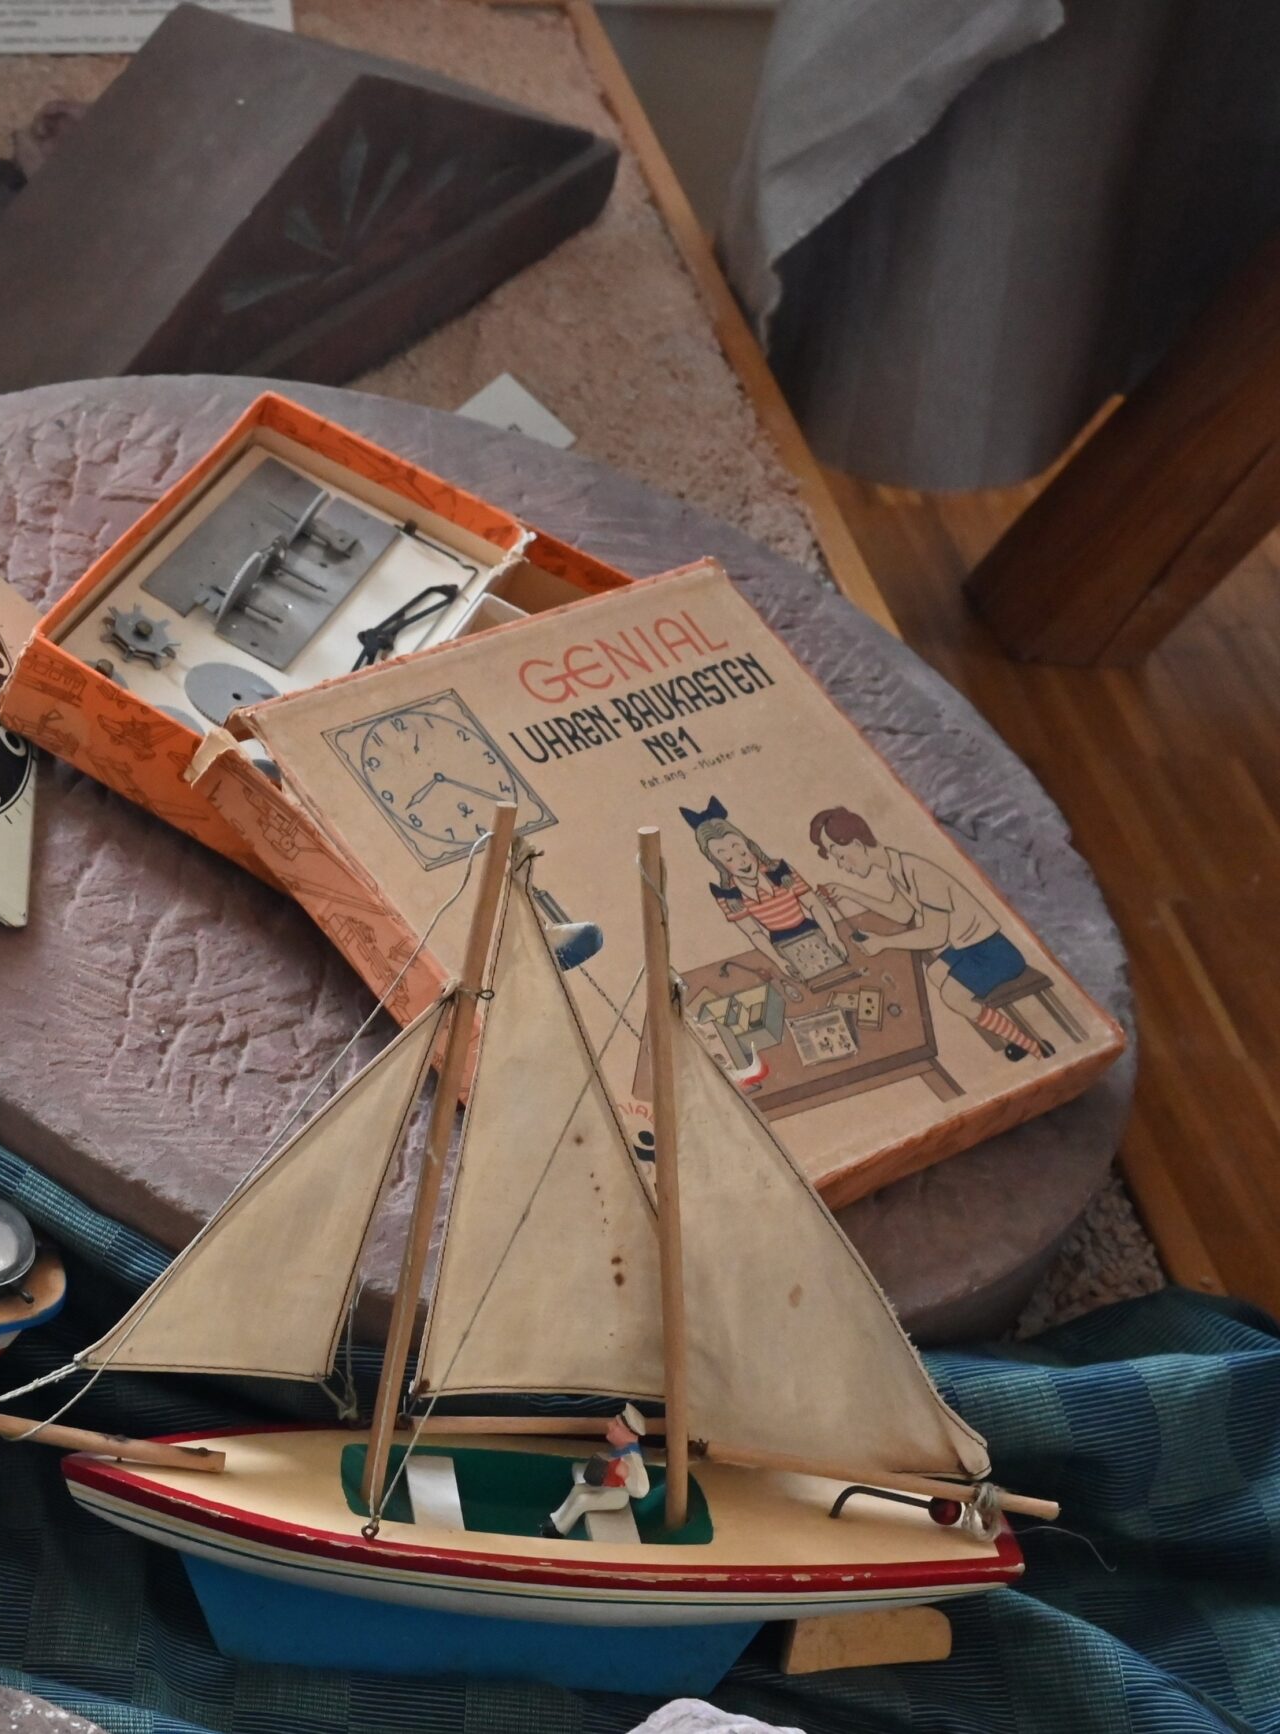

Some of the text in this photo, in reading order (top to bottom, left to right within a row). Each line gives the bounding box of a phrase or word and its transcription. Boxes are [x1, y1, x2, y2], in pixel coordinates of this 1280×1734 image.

[518, 610, 729, 704] GENIAL
[508, 652, 775, 763] UHREN-BAUKASTEN
[390, 717, 408, 732] 12
[423, 717, 434, 729] 1
[371, 731, 384, 747] 11
[456, 729, 471, 742] 2
[482, 751, 496, 765] 3
[498, 780, 511, 794] 4
[380, 790, 394, 804] 9
[407, 813, 423, 828] 8
[444, 827, 456, 841] 7
